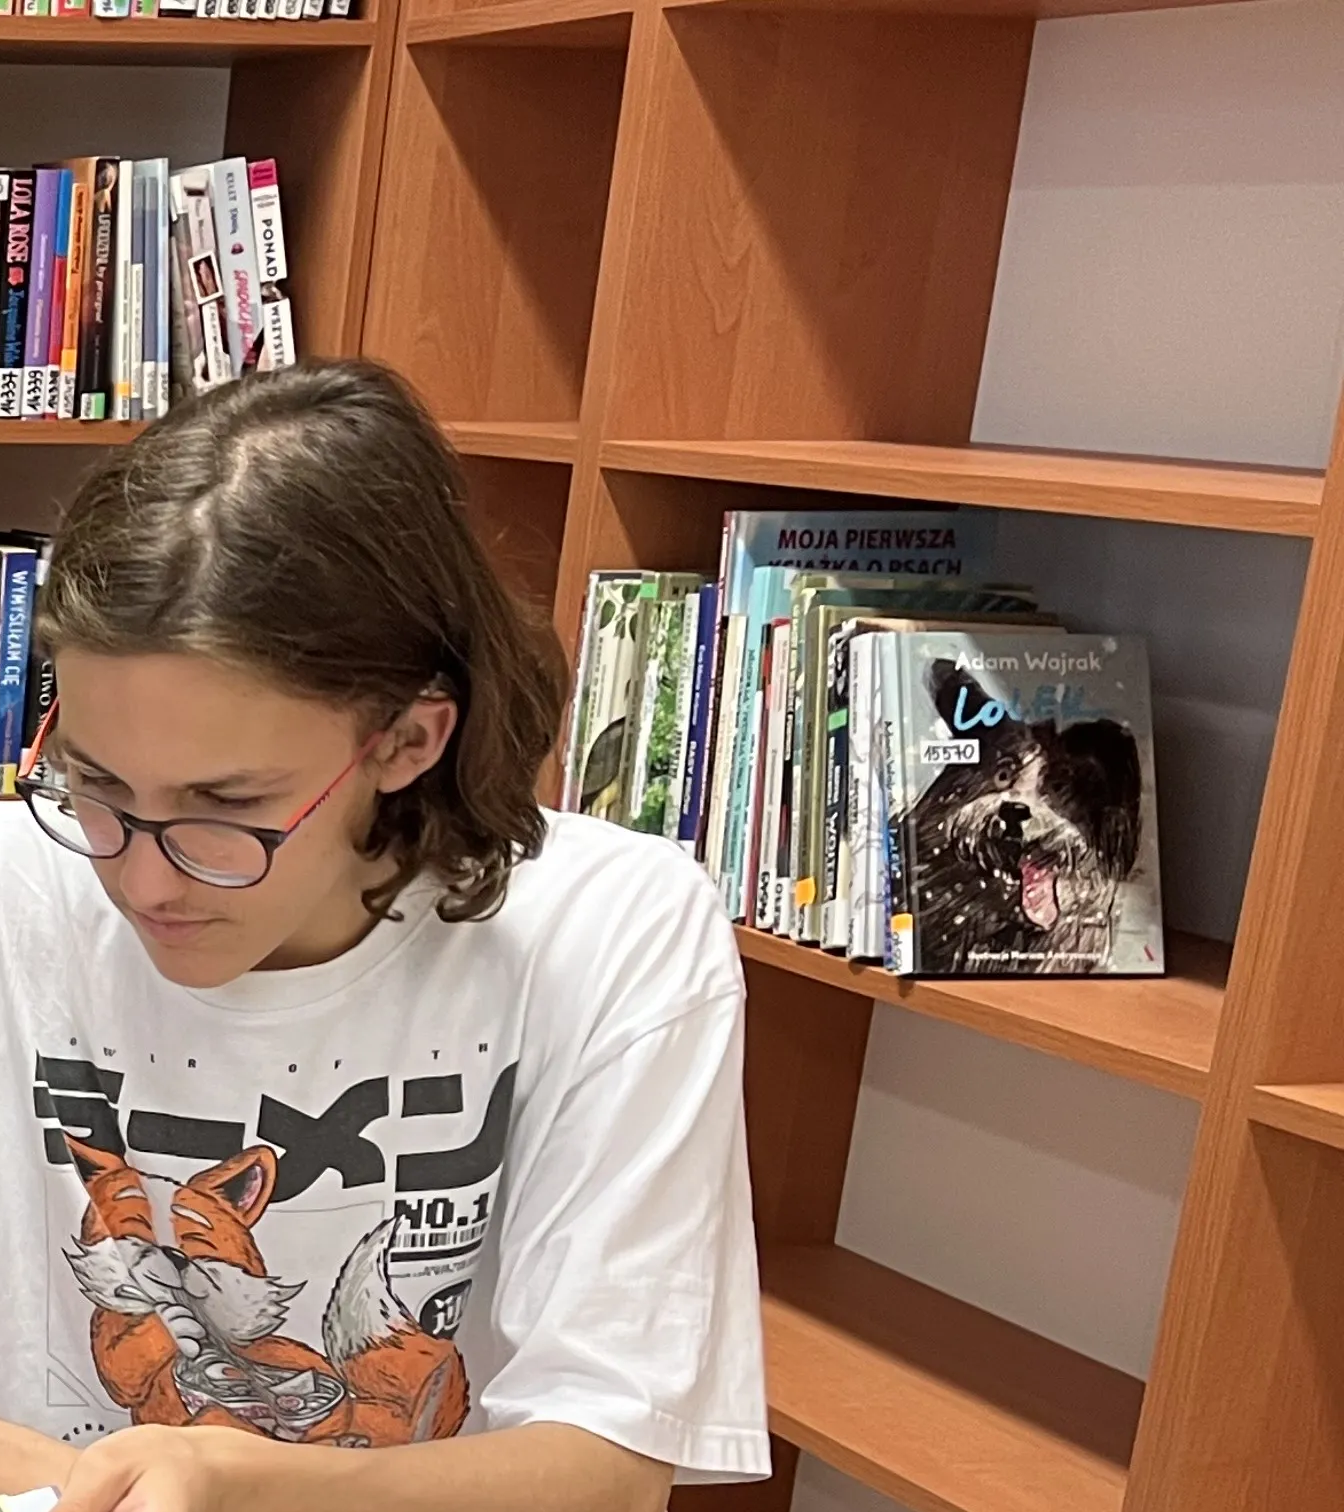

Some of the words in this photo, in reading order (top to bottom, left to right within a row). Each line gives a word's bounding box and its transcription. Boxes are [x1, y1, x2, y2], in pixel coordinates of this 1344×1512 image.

[10, 177, 33, 222] LOLA
[6, 223, 30, 263] ROSE
[262, 218, 278, 278] PONAD
[270, 304, 285, 366] WSZYSTK
[0, 369, 16, 415] 14337
[778, 528, 839, 550] MOJA
[845, 527, 957, 550] PIERWSZA
[4, 570, 30, 661] WYMYŚLIŁAM
[0, 665, 20, 687] CIĘ
[954, 651, 1019, 671] Adam
[1024, 651, 1102, 676] Wajrak
[923, 743, 975, 762] 15570
[394, 1192, 490, 1230] NO.1
